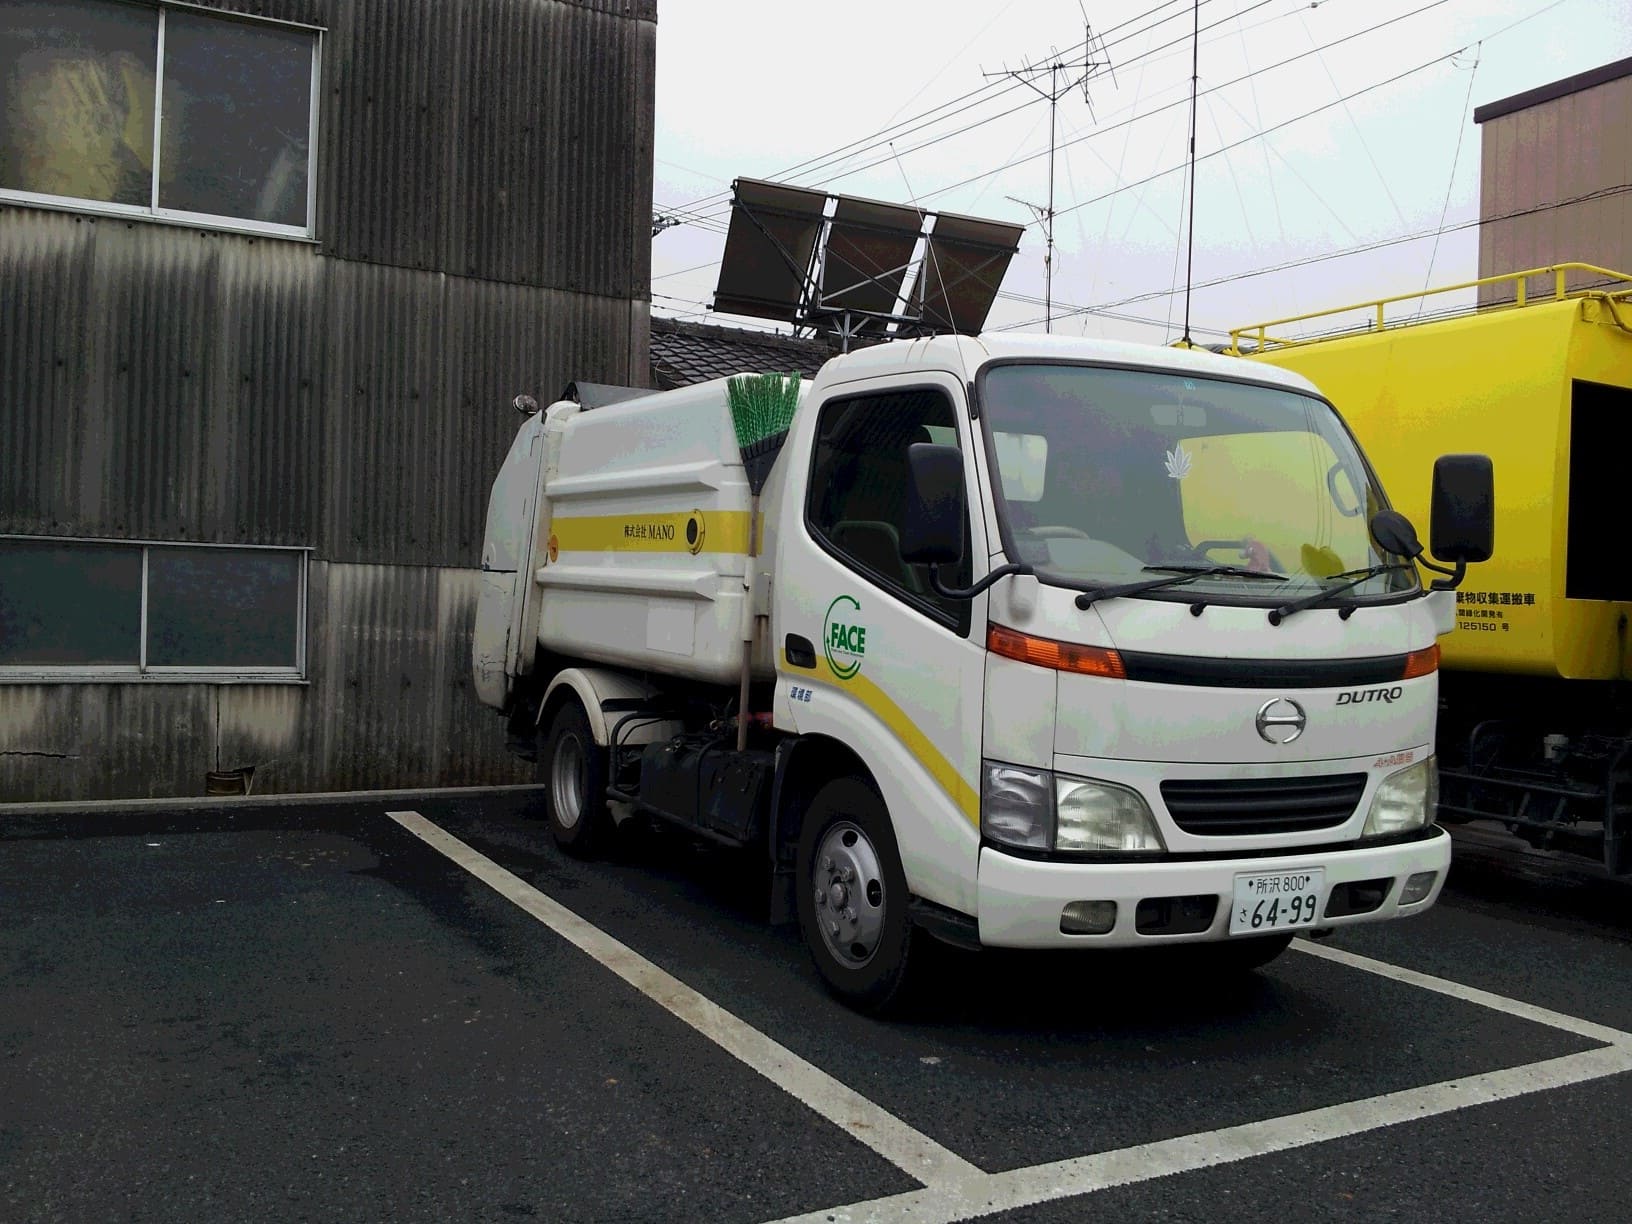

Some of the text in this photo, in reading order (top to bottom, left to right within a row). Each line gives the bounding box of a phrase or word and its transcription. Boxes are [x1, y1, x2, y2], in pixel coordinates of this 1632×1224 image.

[624, 524, 675, 540] 株式会社 MANO
[1459, 622, 1510, 632] 125150 号
[831, 622, 866, 653] FACE
[1336, 686, 1402, 705] DUTRO
[1256, 875, 1304, 894] 所沢 800
[1251, 894, 1316, 928] 64-99
